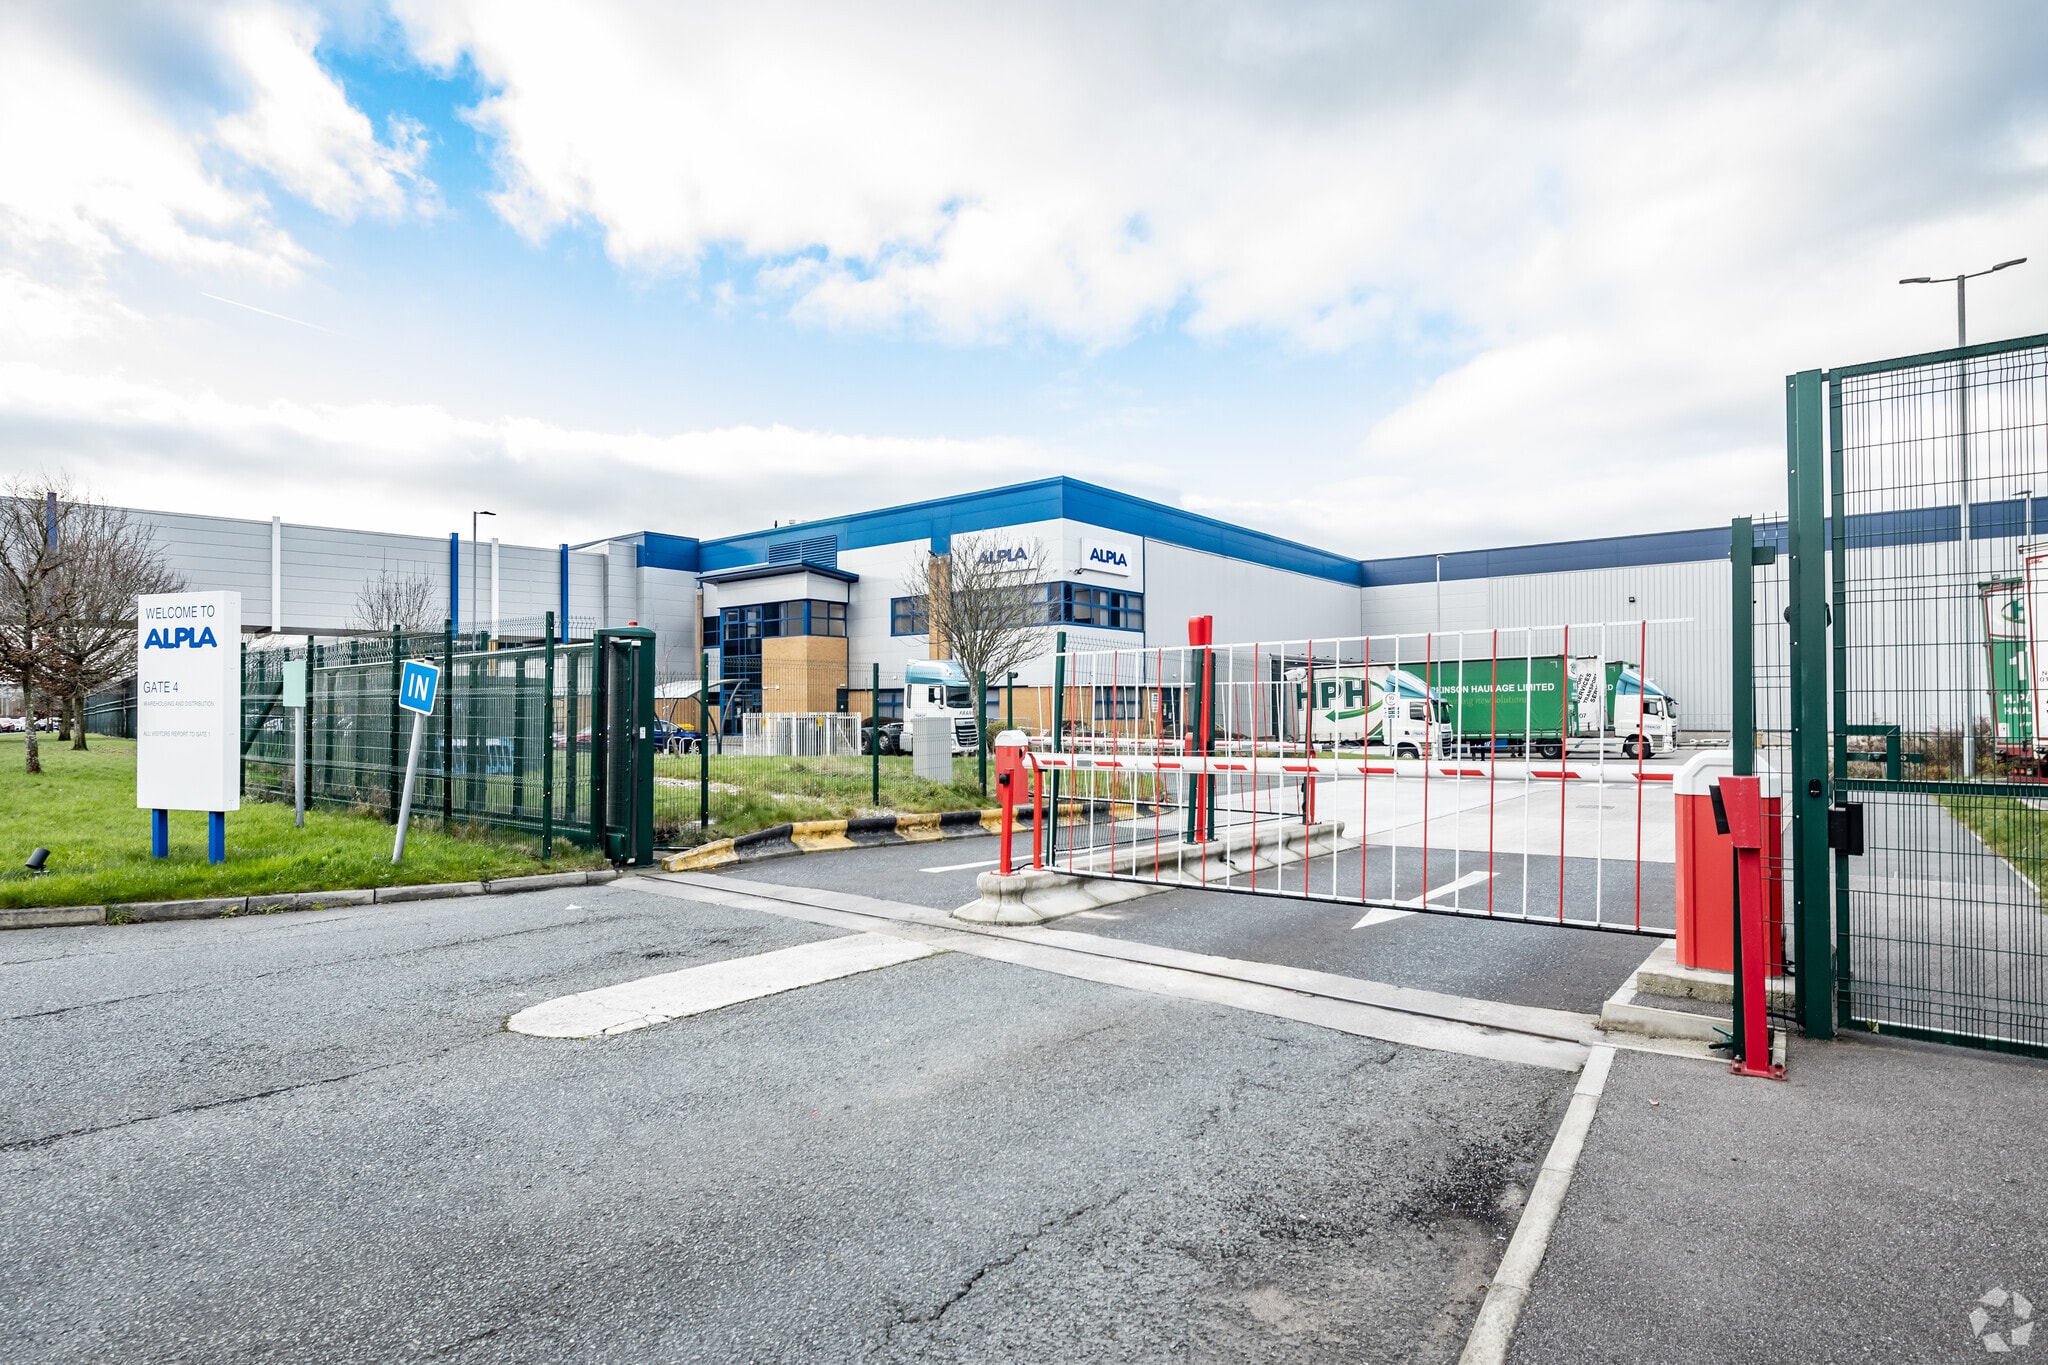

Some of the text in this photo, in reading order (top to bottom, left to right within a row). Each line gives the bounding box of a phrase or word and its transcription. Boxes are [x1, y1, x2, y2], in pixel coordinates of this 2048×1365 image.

[978, 547, 1028, 565] ALPLA
[1090, 547, 1128, 567] ALPLA
[145, 604, 215, 619] WELCOME TO
[144, 626, 218, 650] ALPLA
[143, 681, 179, 693] GATE 4
[407, 673, 430, 701] IN
[1296, 678, 1371, 711] HPH
